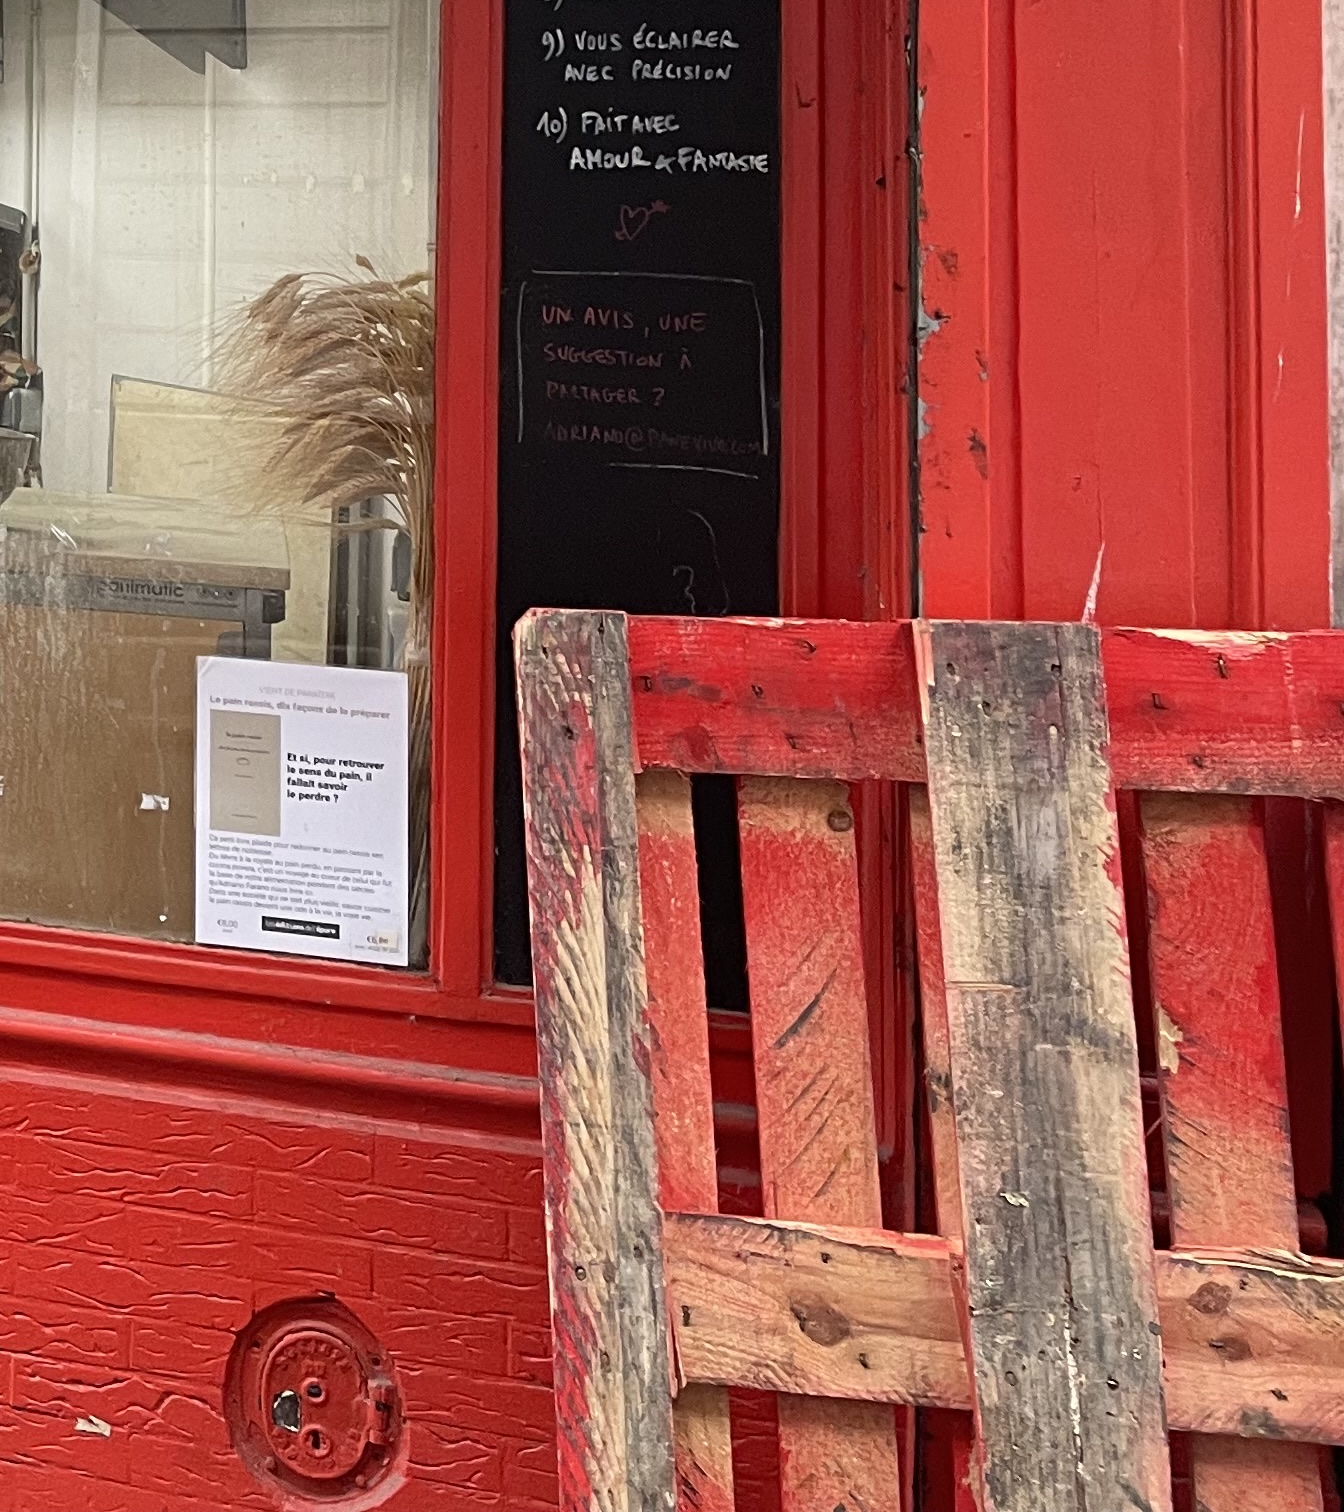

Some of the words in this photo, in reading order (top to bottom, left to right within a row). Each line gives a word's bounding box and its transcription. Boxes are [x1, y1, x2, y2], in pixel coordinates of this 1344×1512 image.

[541, 28, 565, 61] 9)
[575, 31, 623, 51] VOUS
[633, 23, 739, 50] ÉCLAIRER
[565, 64, 614, 82] AVEC
[631, 59, 732, 81] PRÉCISION
[581, 106, 629, 134] FAIT
[631, 114, 680, 133] AVEC
[569, 146, 652, 171] AMOUR
[677, 146, 769, 174] FANTASIE
[660, 312, 707, 331] UNE
[543, 343, 662, 368] SUGGESTION
[652, 388, 665, 406] ?
[287, 752, 297, 762] Et
[313, 756, 336, 765] pour
[338, 759, 385, 770] retrouver
[298, 767, 322, 776] sens
[324, 768, 337, 778] du
[287, 776, 315, 788] fallait
[317, 782, 348, 791] savoir
[298, 791, 331, 801] perdre
